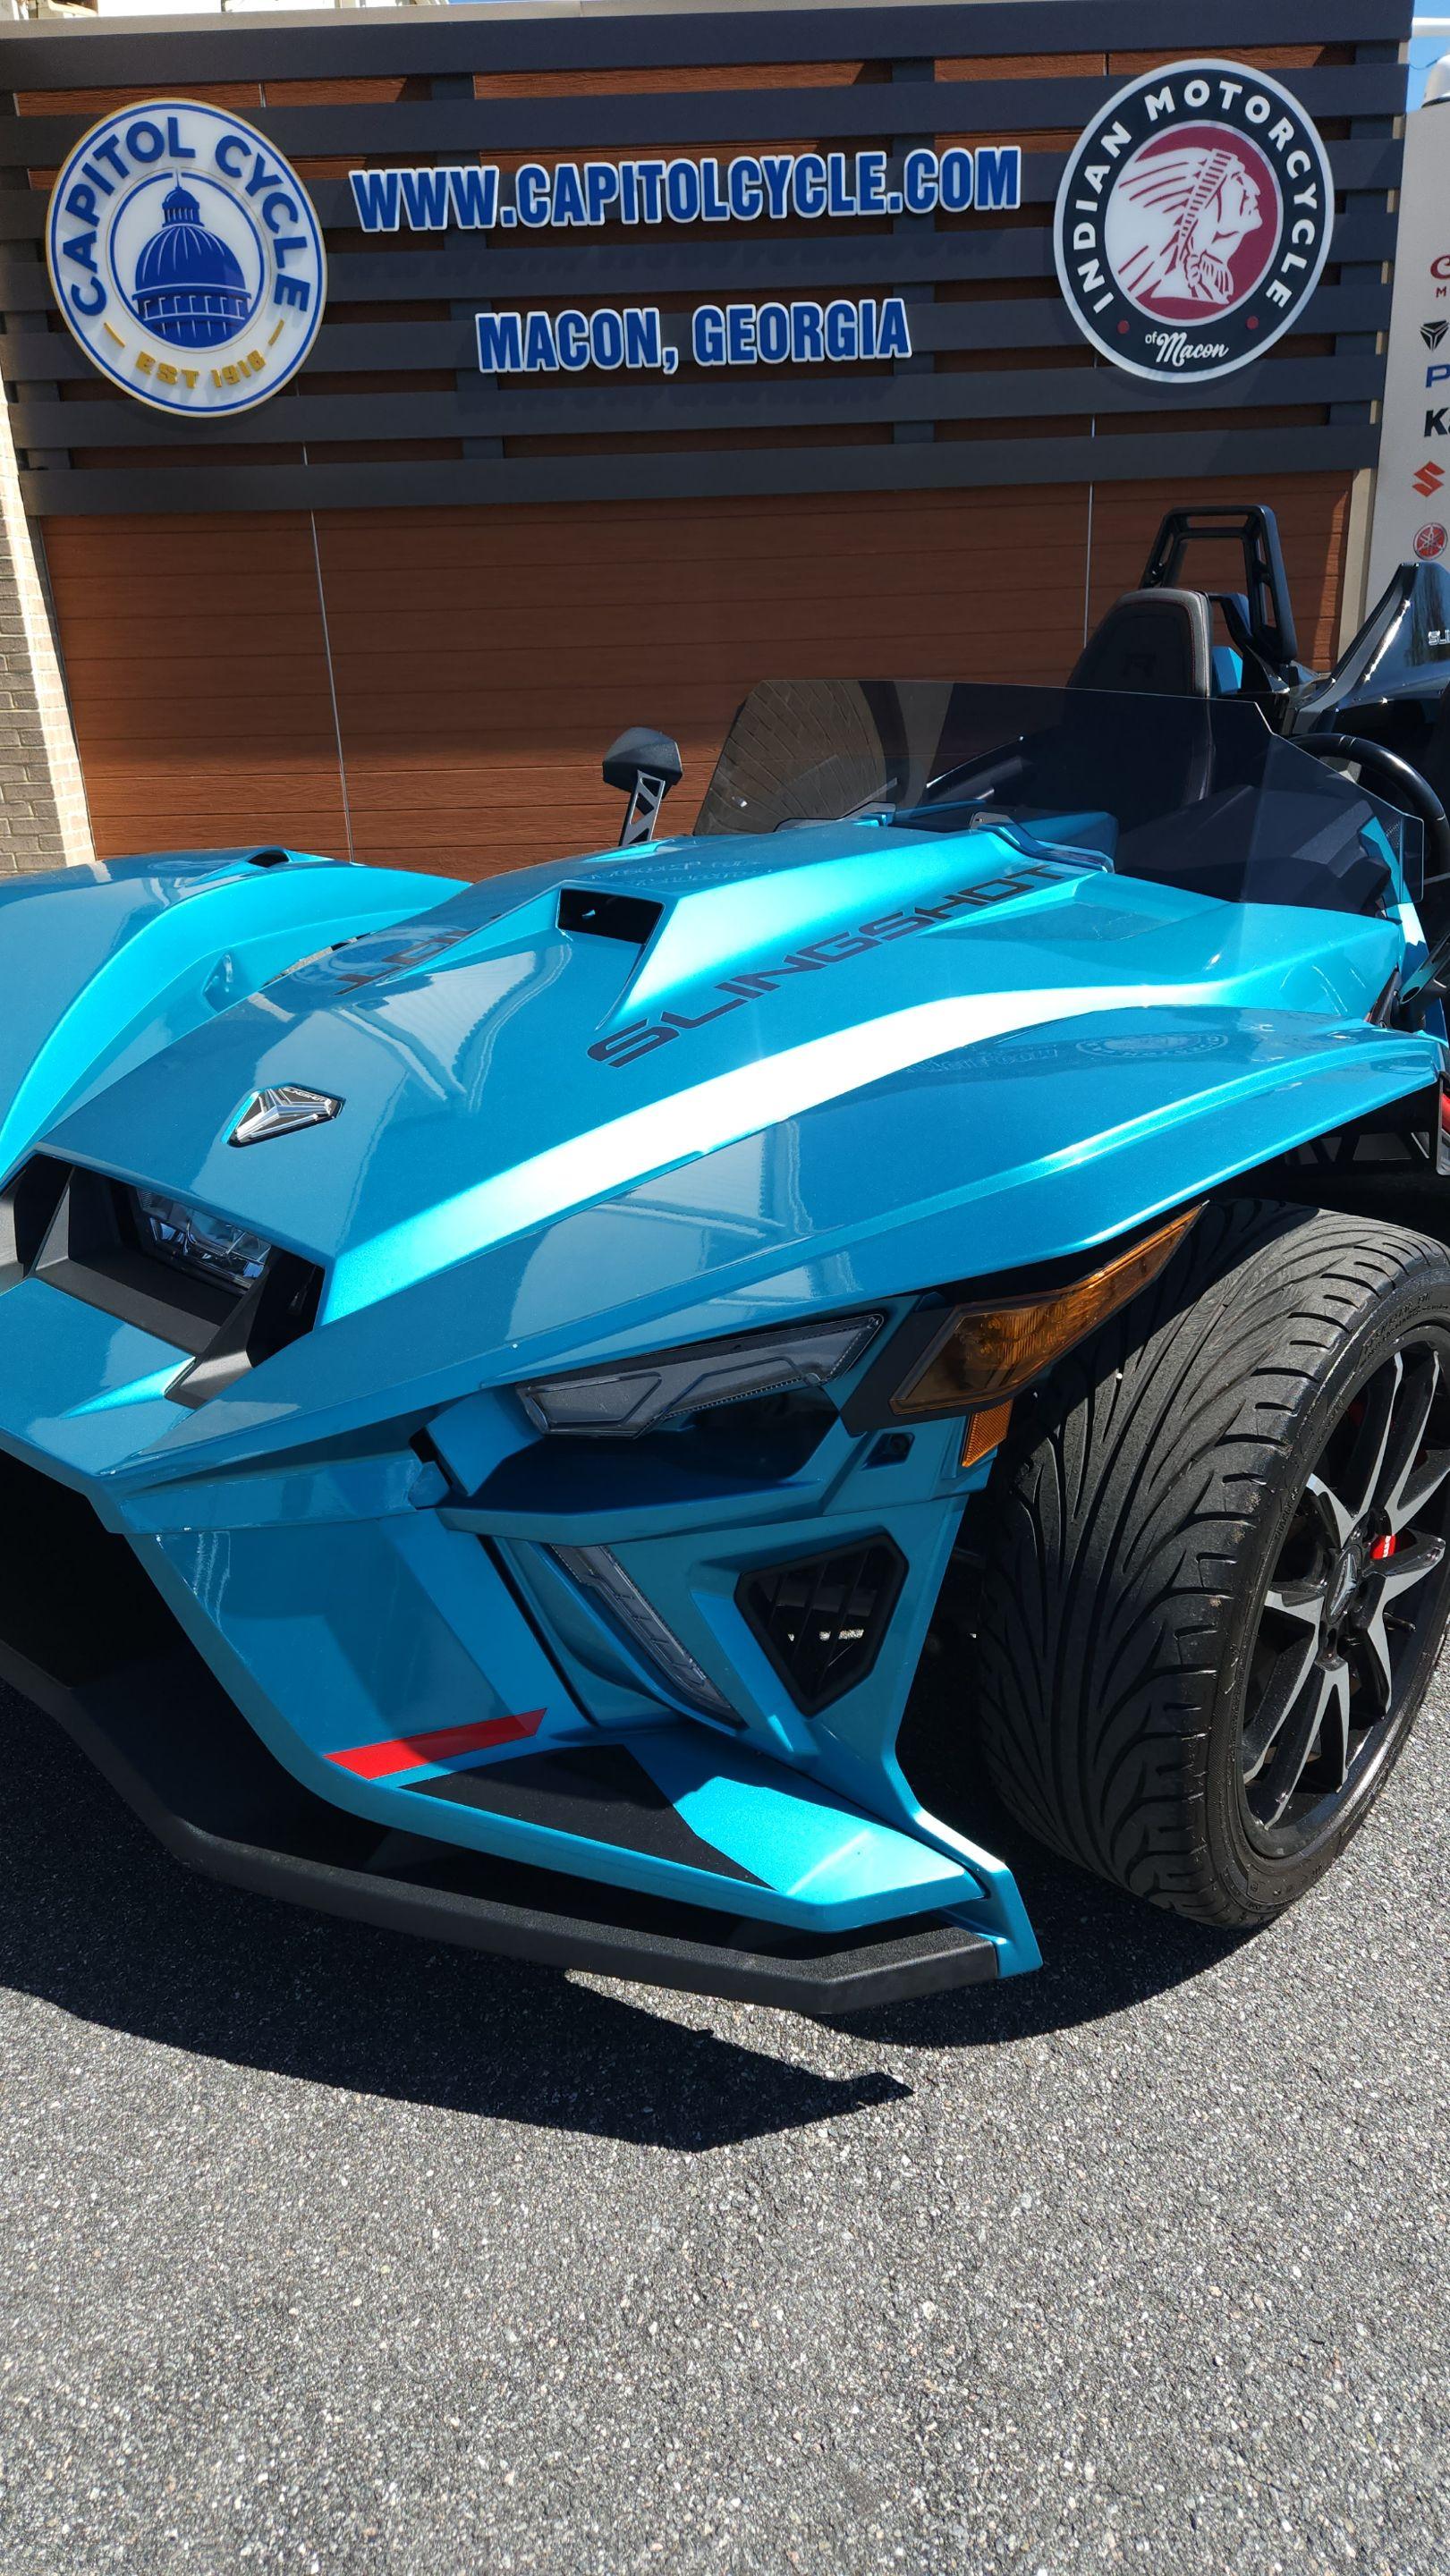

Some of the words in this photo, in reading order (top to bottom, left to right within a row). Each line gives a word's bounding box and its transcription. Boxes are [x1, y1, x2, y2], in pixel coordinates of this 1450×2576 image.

[63, 116, 196, 317] CAPITOL
[215, 134, 311, 312] CYCLE
[349, 146, 1022, 233] WWW.CAPITOLCYCLE.COM
[1073, 121, 1132, 314] INDIAN
[1143, 79, 1318, 308] MOTORCYCLE
[135, 351, 201, 389] EST
[475, 307, 679, 374] MACON,
[691, 297, 912, 368] GEORGIA
[1145, 332, 1158, 345] of
[1155, 331, 1230, 368] Macon
[587, 864, 1065, 1069] SLINGSHOT
